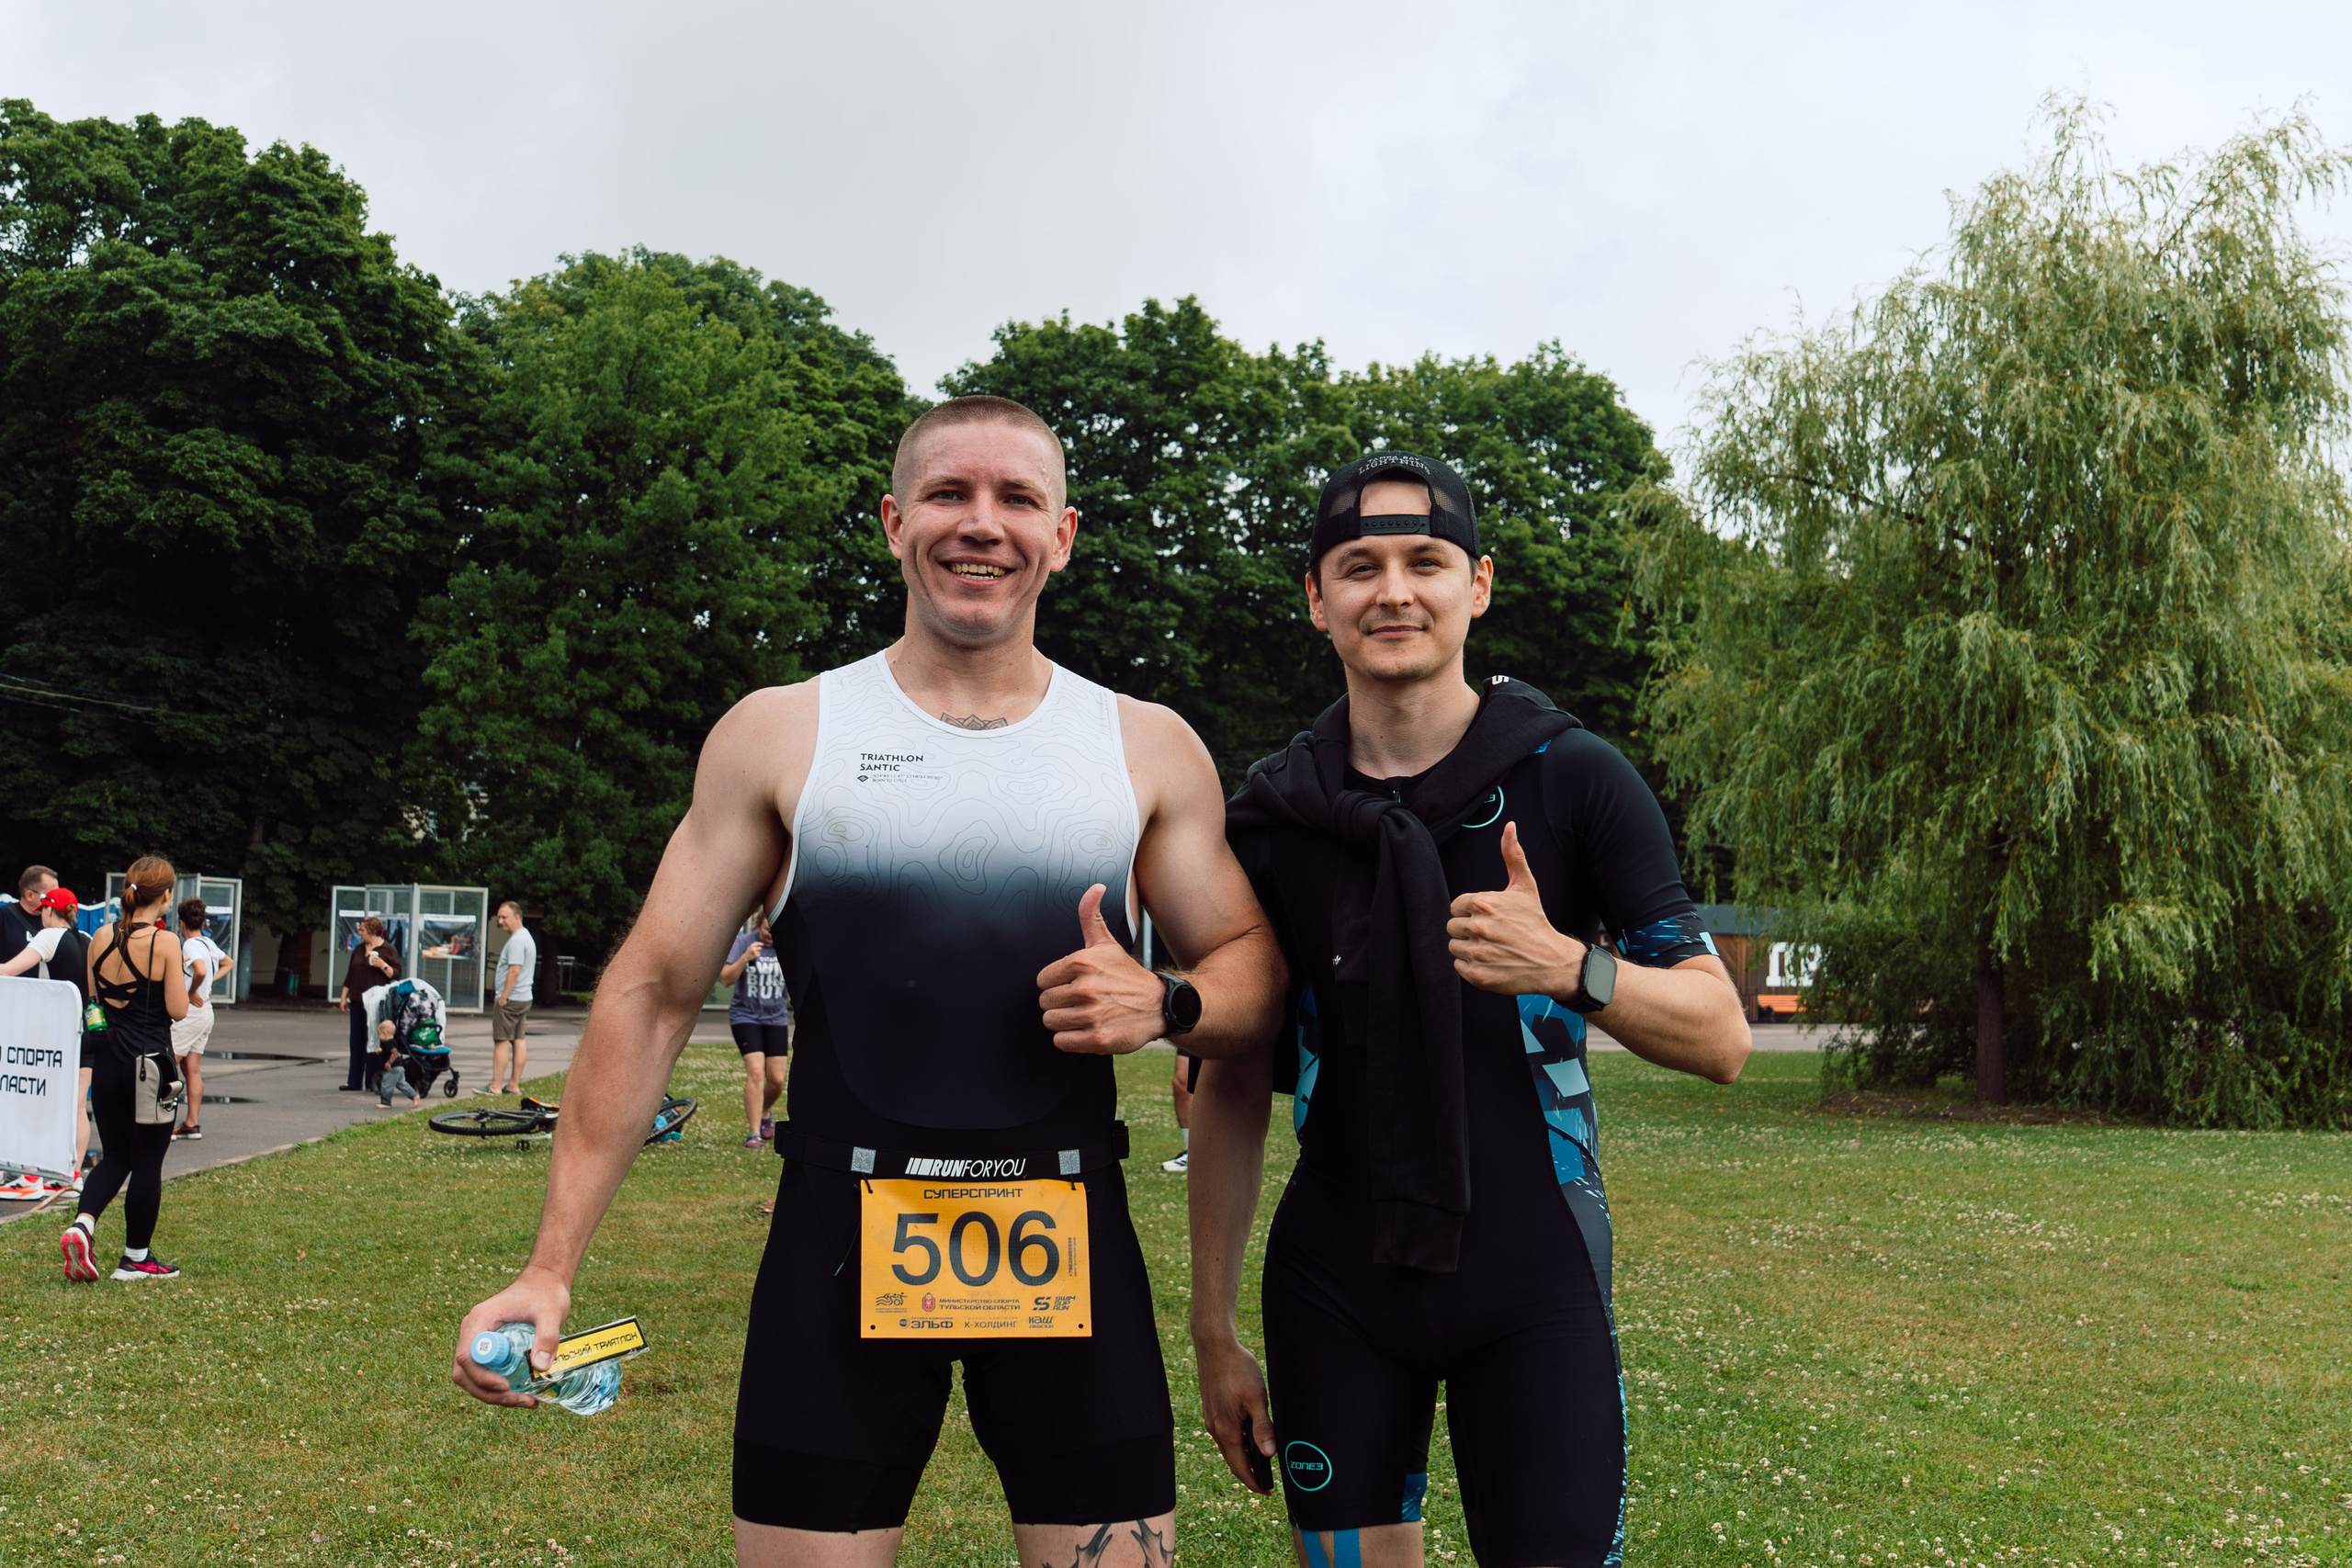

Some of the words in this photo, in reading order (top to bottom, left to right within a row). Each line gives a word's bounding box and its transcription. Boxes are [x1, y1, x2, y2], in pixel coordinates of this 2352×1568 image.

[1359, 457, 1430, 475] LIGHTNING
[860, 752, 924, 762] TRIATHLON
[860, 763, 900, 772] SANTIC
[6, 1046, 62, 1068] СПОРТА
[923, 1188, 1023, 1199] СУПЕРСПРИНТ
[891, 1210, 1060, 1286] 506
[910, 1320, 954, 1328] ЭЛЬФ
[594, 1331, 639, 1350] ТРИАТЛОН
